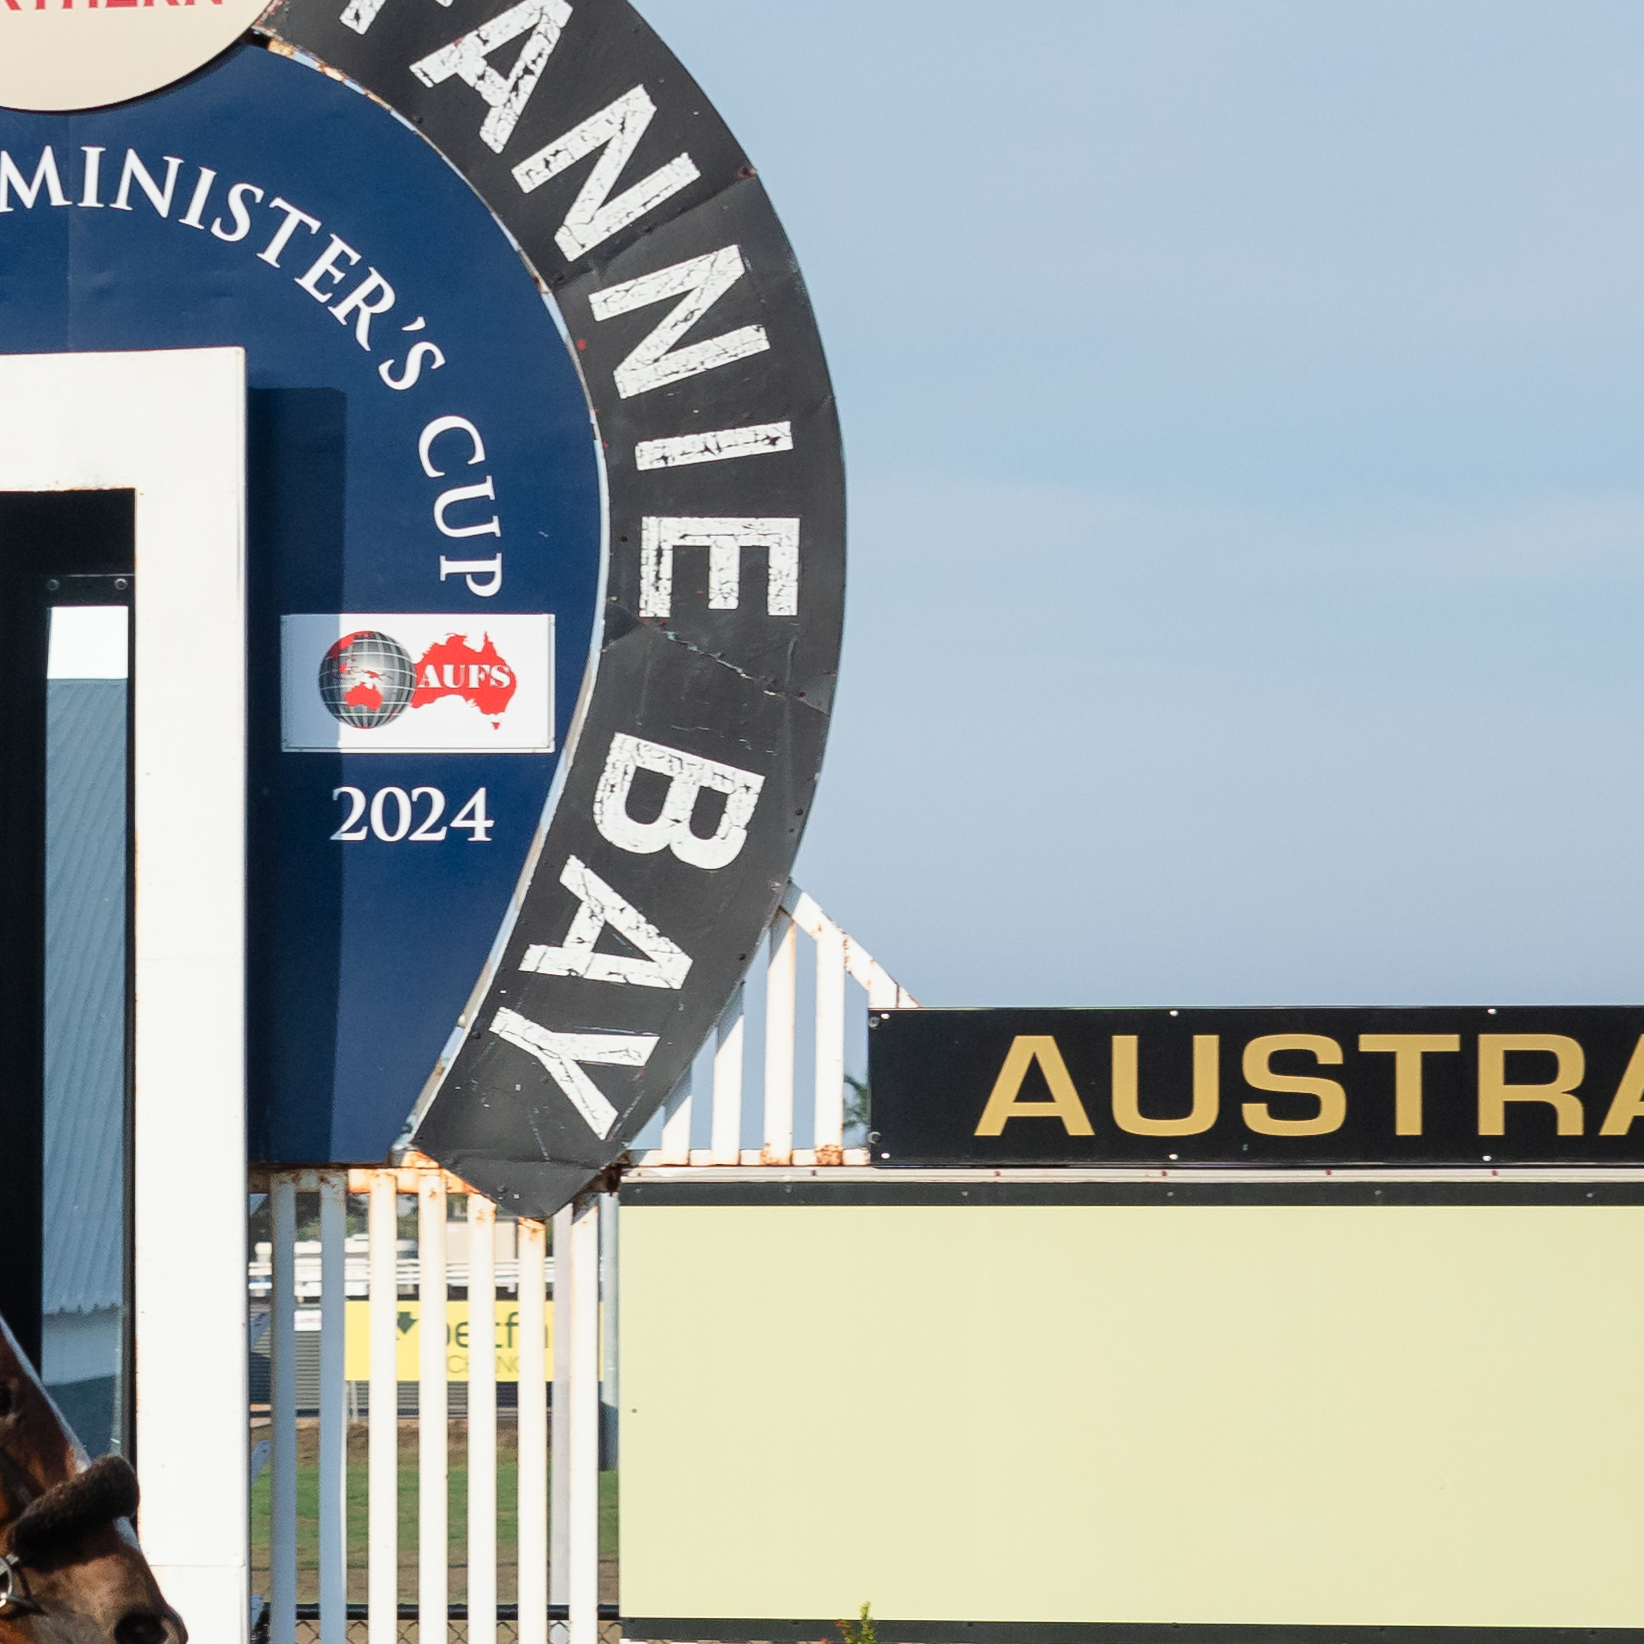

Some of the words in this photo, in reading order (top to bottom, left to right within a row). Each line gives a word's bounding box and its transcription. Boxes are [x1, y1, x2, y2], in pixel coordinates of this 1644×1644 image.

[340, 0, 800, 618] ANNIE
[417, 415, 503, 597] CUP
[417, 663, 512, 689] AUFS
[330, 786, 495, 843] 2024
[488, 732, 765, 1141] BAY
